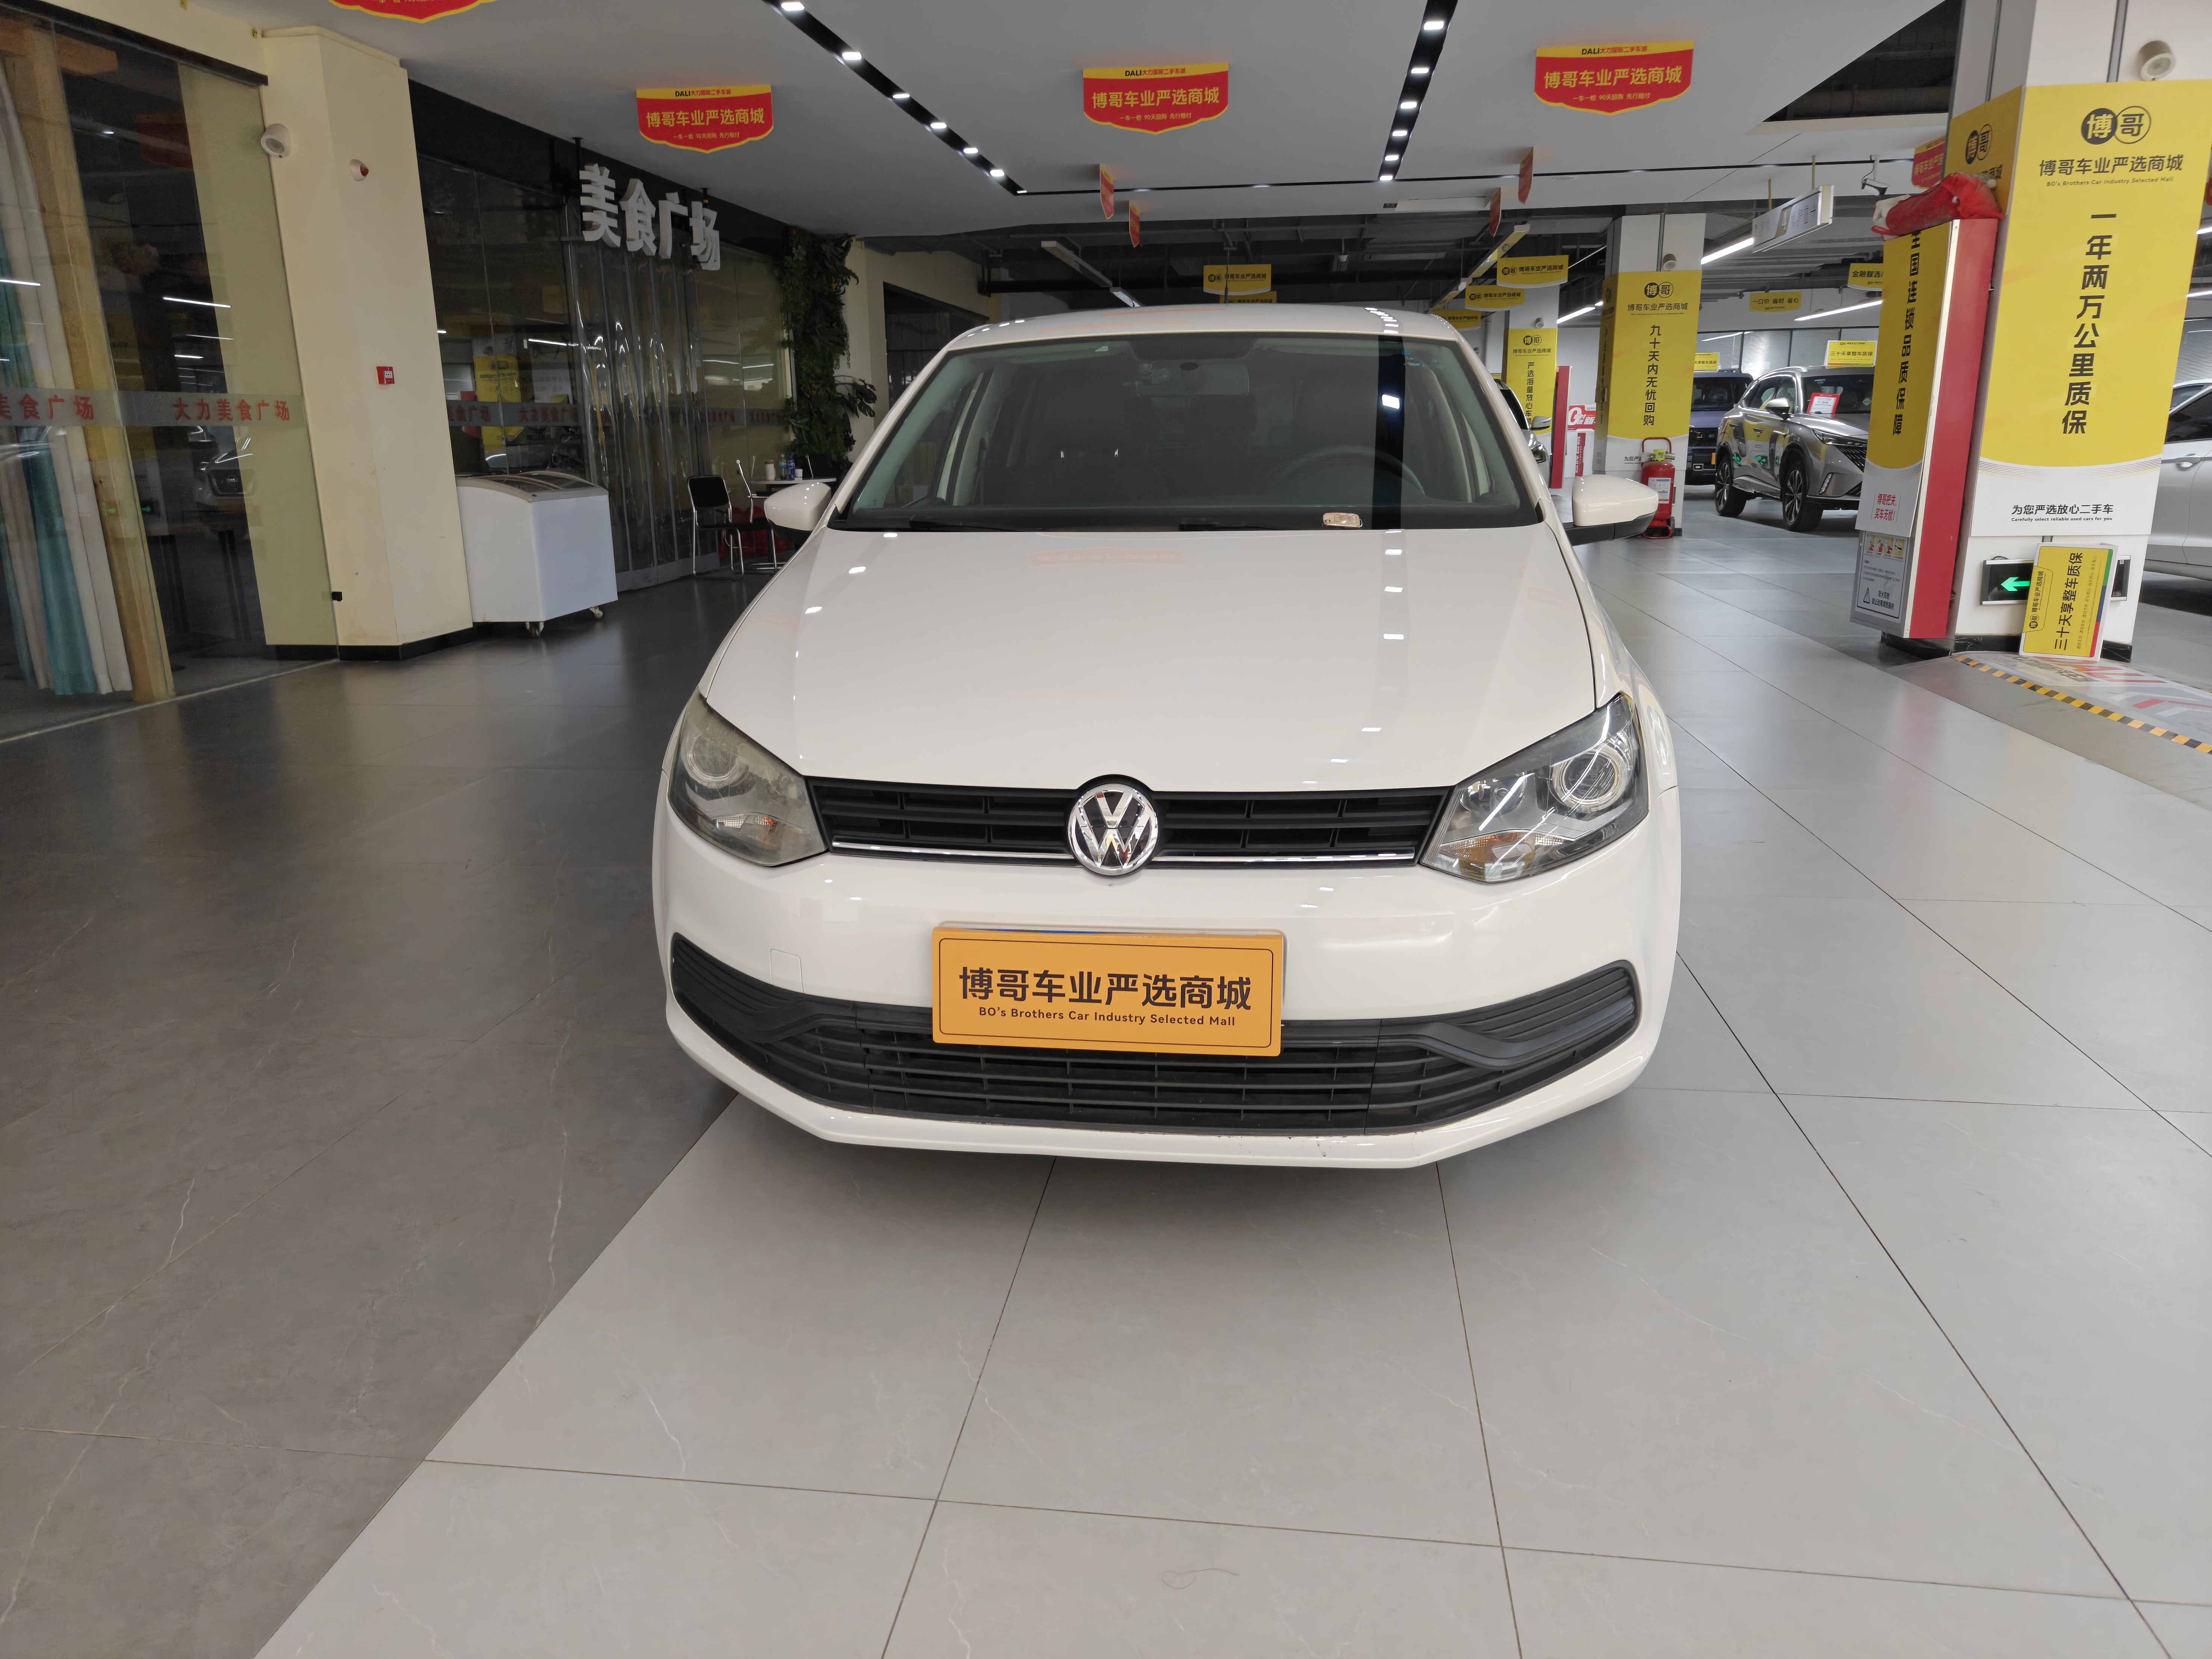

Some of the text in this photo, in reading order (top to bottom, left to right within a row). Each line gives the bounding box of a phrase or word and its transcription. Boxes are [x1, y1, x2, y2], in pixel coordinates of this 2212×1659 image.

[1544, 66, 1682, 89] 博哥车业严选商城
[1092, 87, 1219, 109] 博哥车业严选商城
[646, 107, 765, 128] 博哥车业严选商城
[2086, 113, 2145, 139] 博哥
[2040, 154, 2184, 177] 博哥车业严选商城
[579, 163, 720, 270] 美食广场
[1628, 302, 1688, 311] 博哥车业严选商城
[2062, 214, 2117, 434] 一年两万公里质保
[1643, 325, 1661, 425] 九十天内无忧回购
[174, 397, 290, 421] 大力美食广场
[2012, 504, 2114, 515] 为您严选放心二手车
[2031, 571, 2044, 612] 博哥车业严选商城
[2054, 552, 2083, 651] 三十天享整车质保
[959, 966, 1251, 1011] 博哥车业严选商城
[979, 1007, 1235, 1026] BO's Brothers Car Industry Selected Mall
